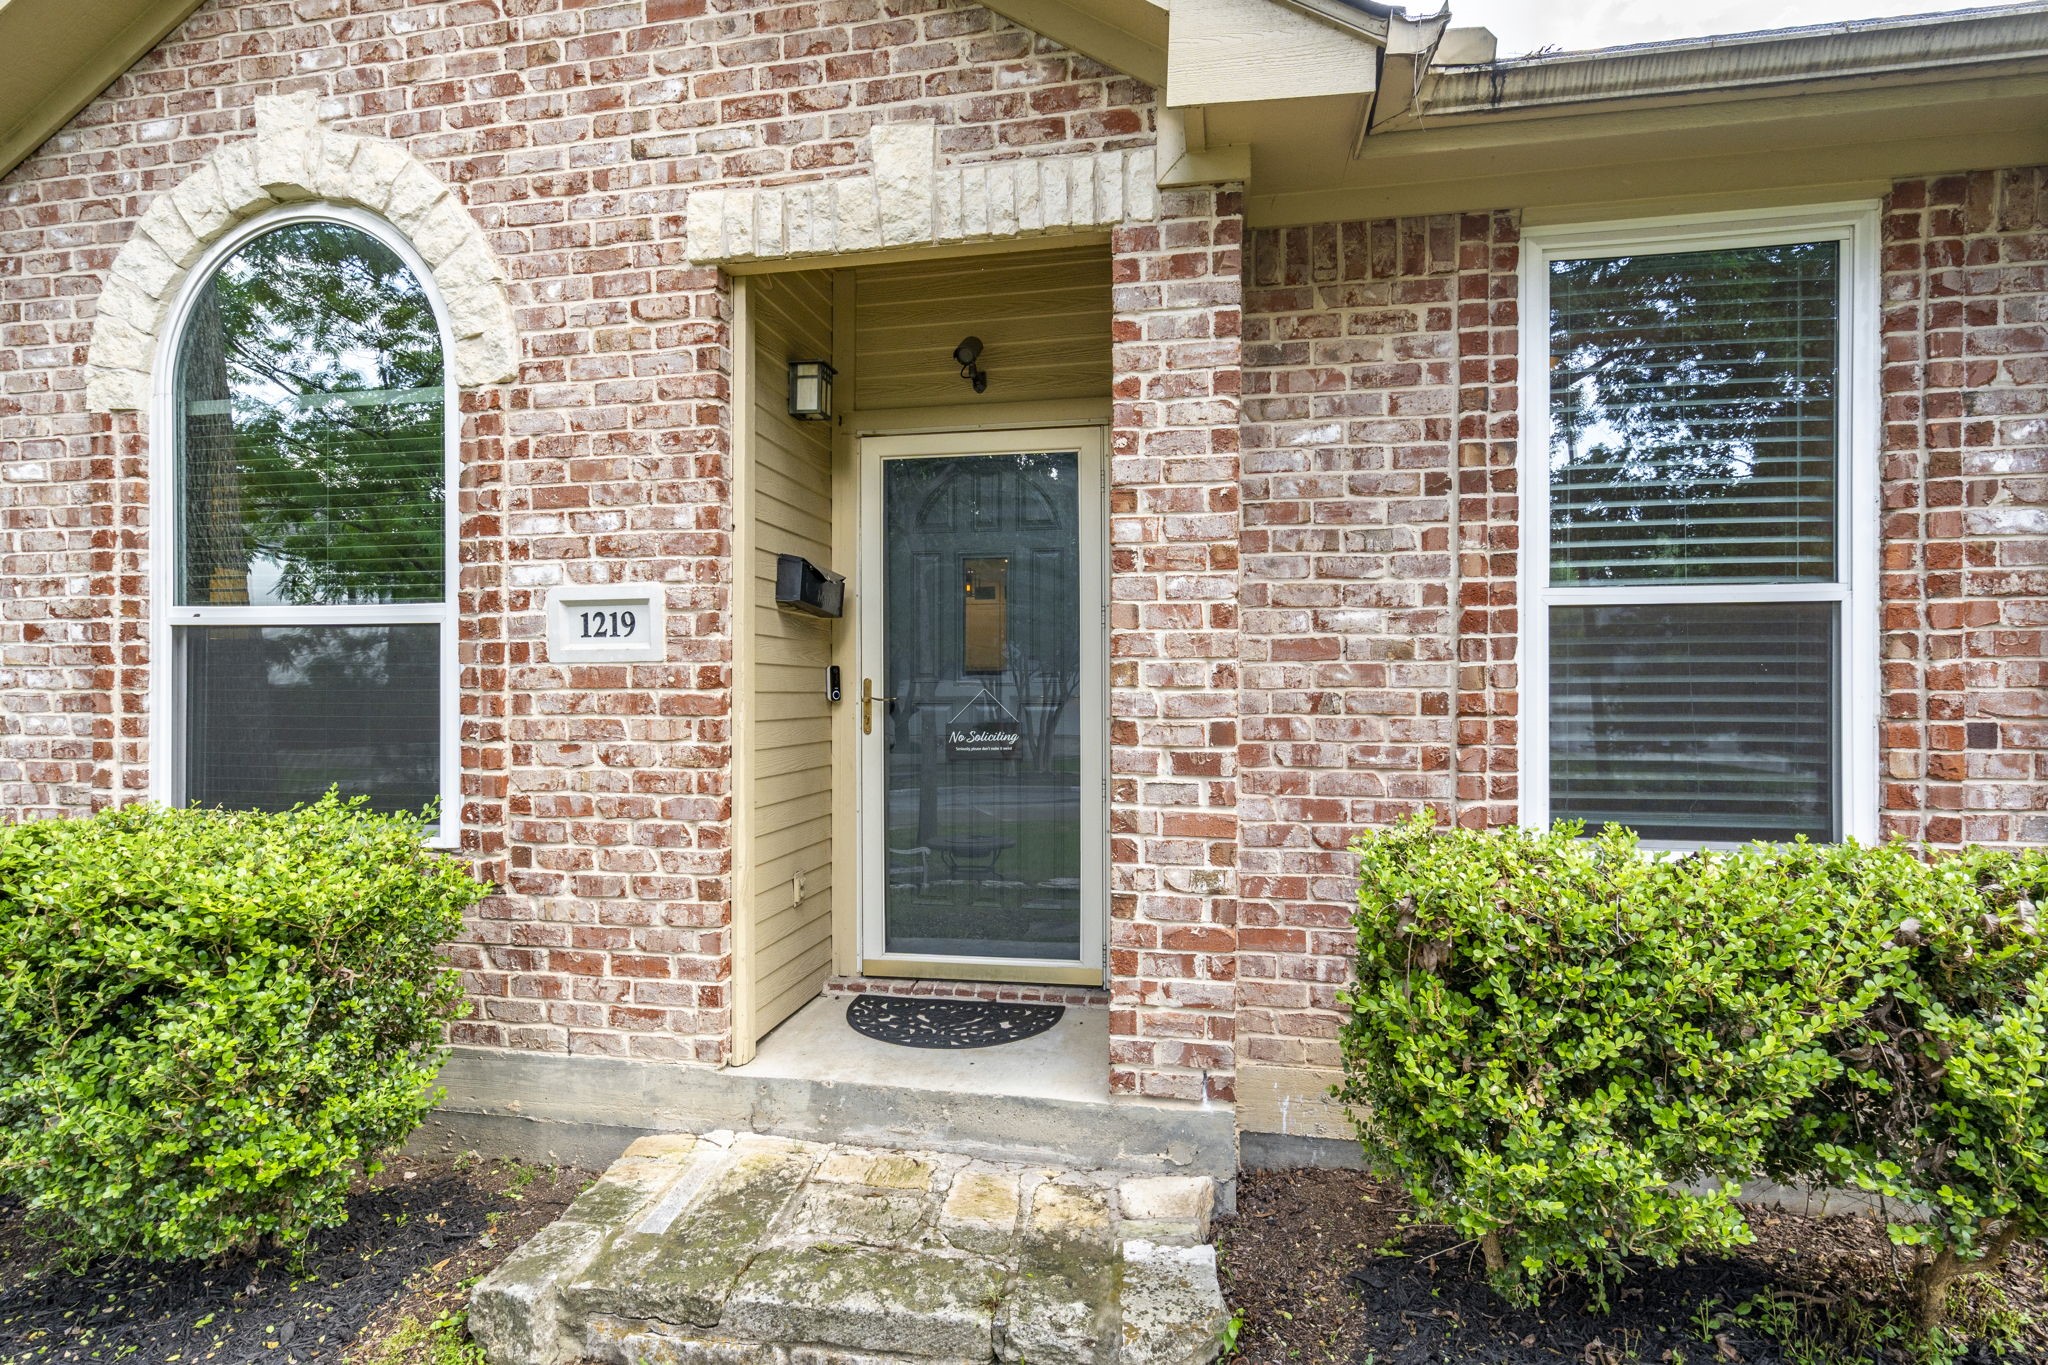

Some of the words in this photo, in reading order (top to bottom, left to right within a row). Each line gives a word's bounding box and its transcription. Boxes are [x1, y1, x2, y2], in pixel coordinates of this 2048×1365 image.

[580, 611, 636, 638] 1219
[948, 731, 966, 744] No
[966, 730, 1020, 745] Soliciting
